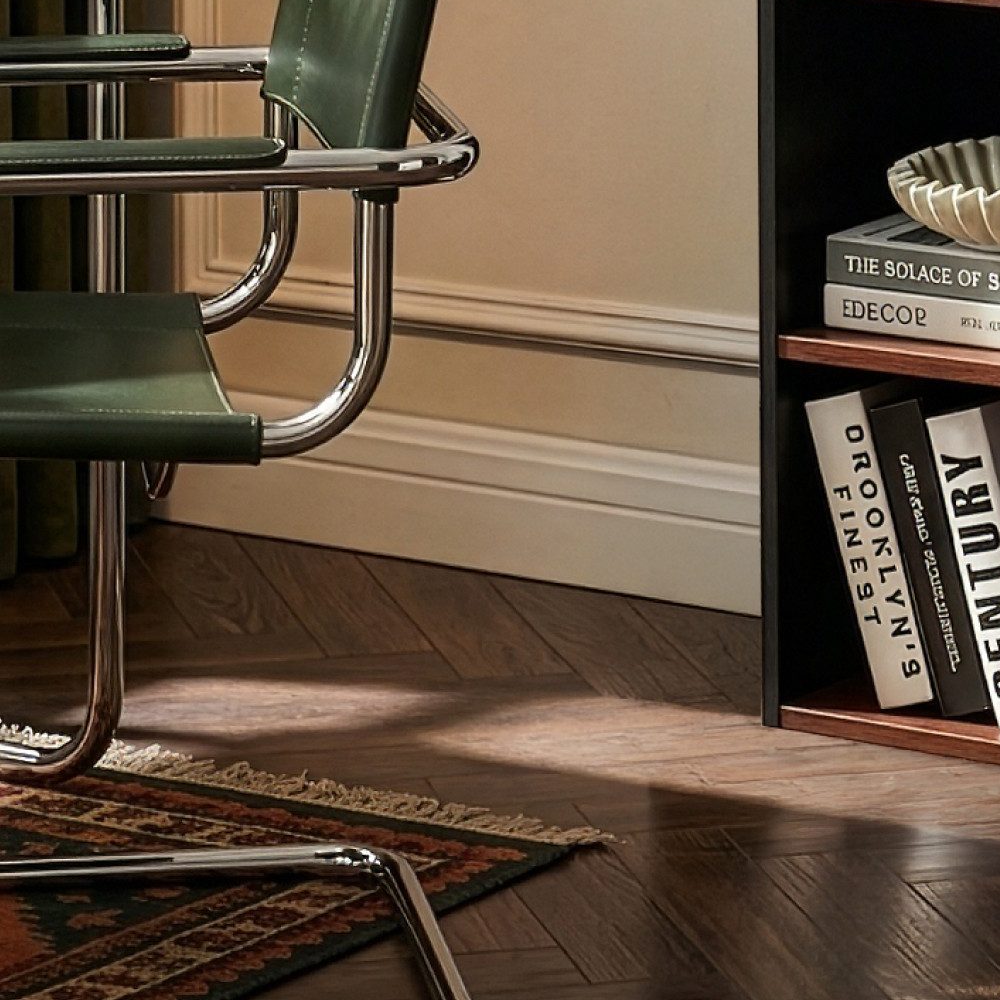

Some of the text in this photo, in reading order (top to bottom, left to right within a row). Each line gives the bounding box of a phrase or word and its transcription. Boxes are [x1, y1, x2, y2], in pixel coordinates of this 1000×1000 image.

[884, 260, 953, 285] SOLACE
[957, 268, 982, 288] OF
[832, 484, 882, 625] FINEST
